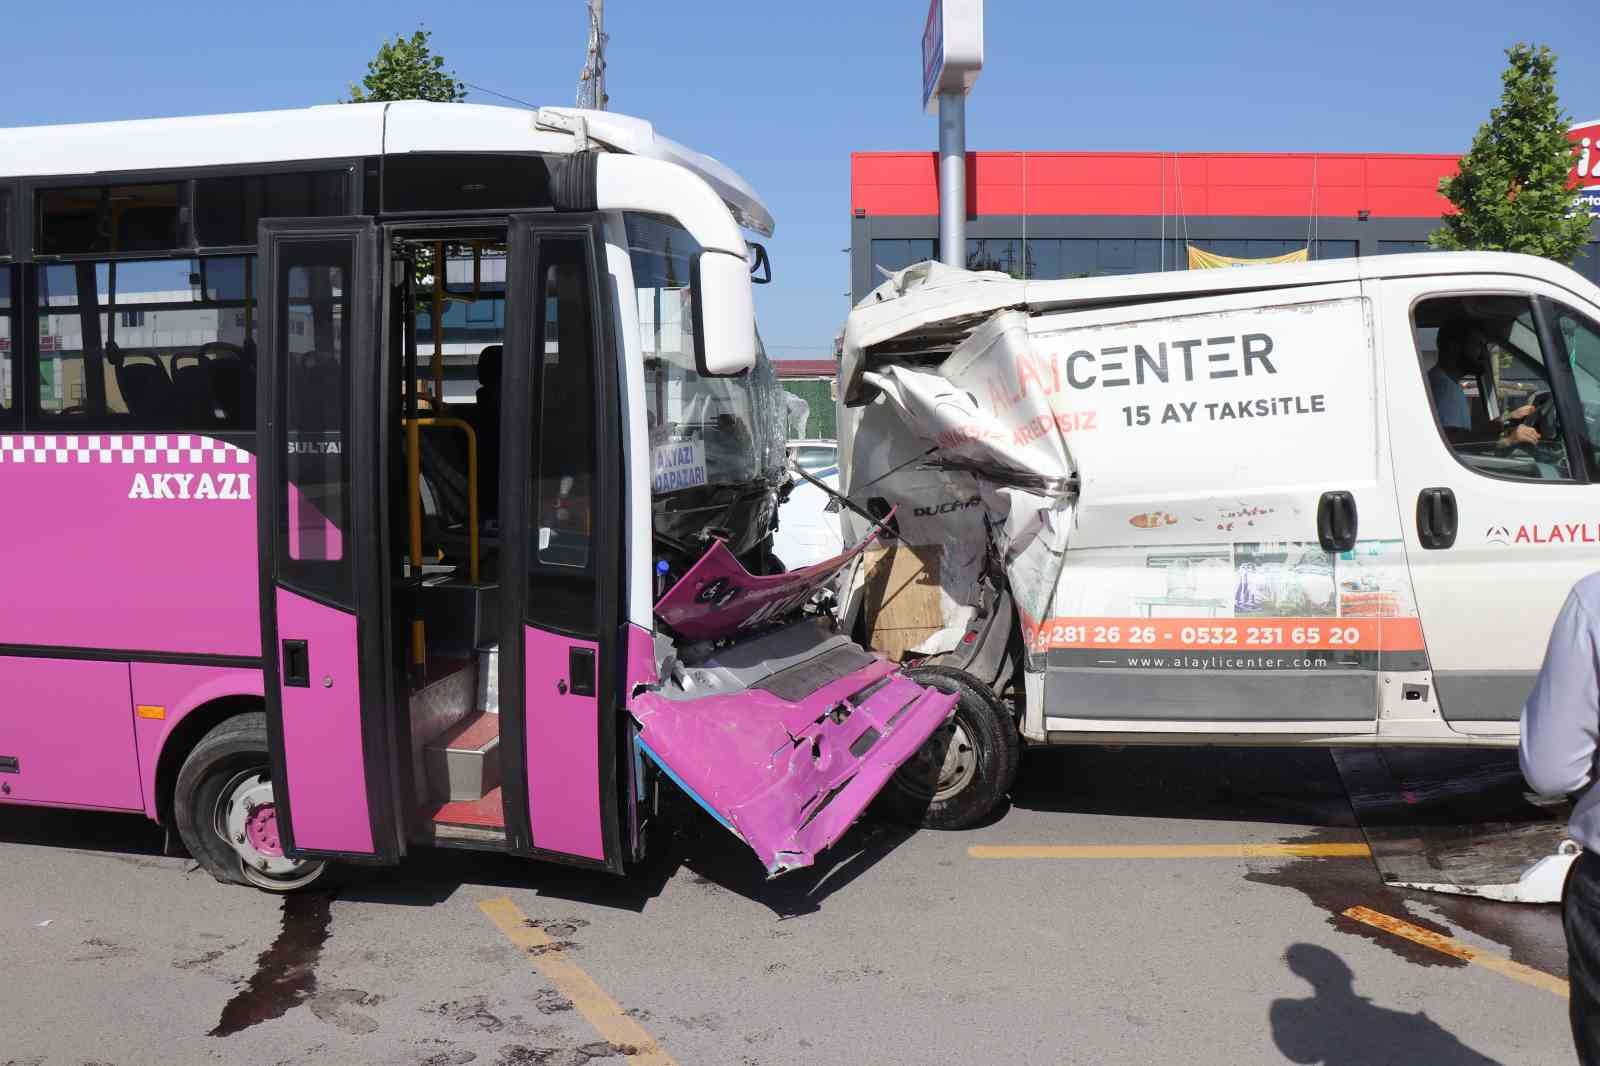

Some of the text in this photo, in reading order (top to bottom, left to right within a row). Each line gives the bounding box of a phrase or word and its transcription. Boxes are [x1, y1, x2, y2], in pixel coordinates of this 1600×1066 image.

[1066, 333, 1277, 390] CENTER
[1122, 405, 1151, 427] 15
[1161, 402, 1197, 424] AY
[128, 472, 251, 500] AKYAZI
[1052, 626, 1086, 643] 281
[1094, 626, 1121, 643] 26
[1128, 626, 1157, 643] 26
[1180, 626, 1238, 644] 0532
[1245, 626, 1283, 644] 231
[1291, 626, 1321, 644] 65
[1328, 626, 1360, 644] 20
[1127, 655, 1328, 669] www.alaylicenter.com
